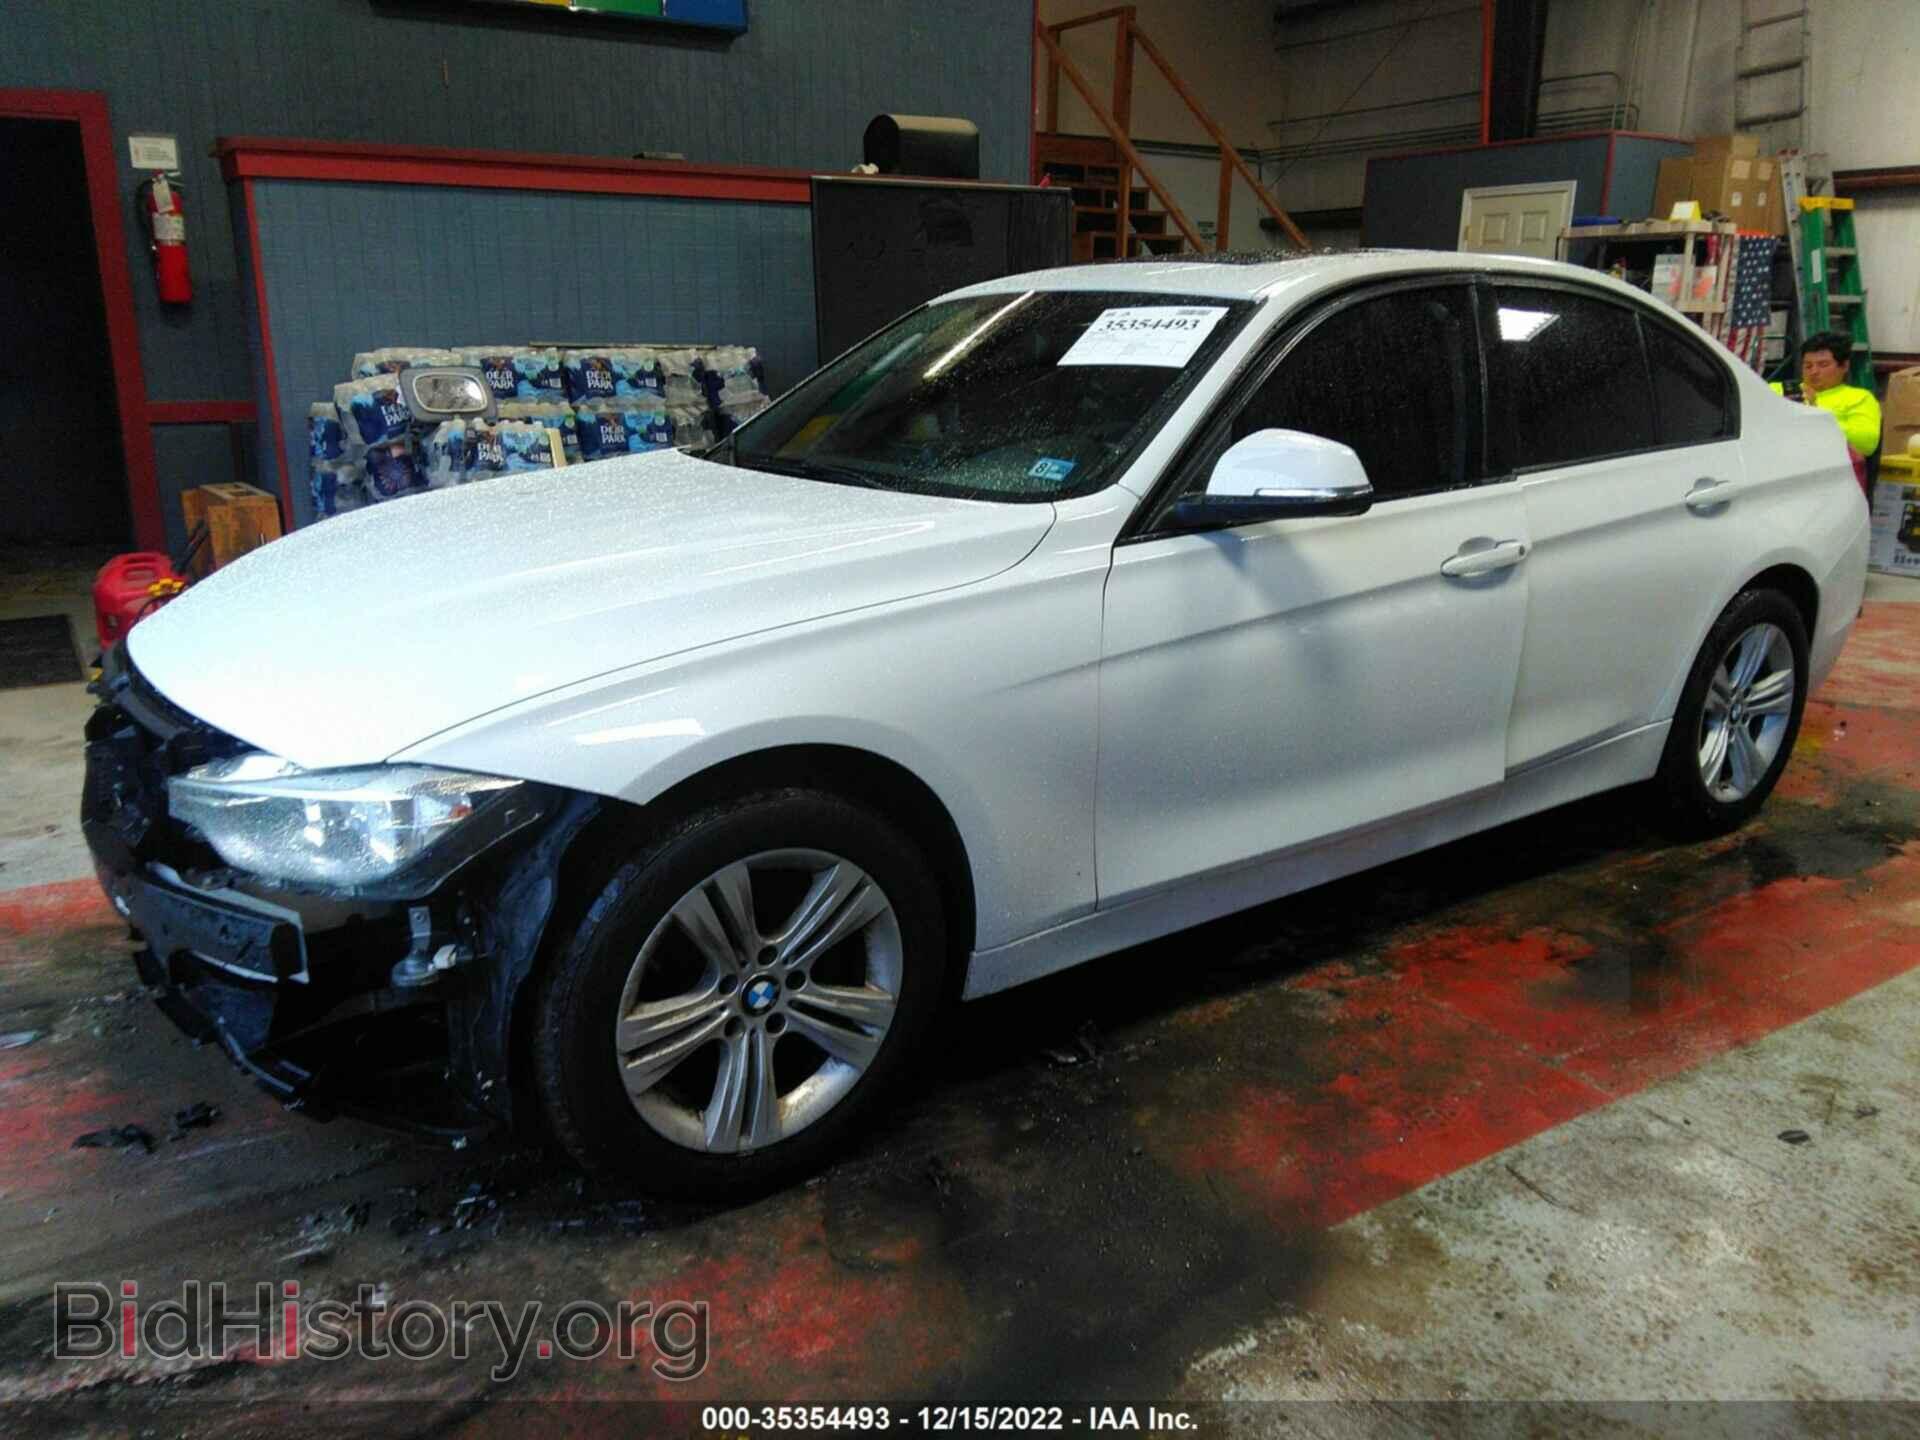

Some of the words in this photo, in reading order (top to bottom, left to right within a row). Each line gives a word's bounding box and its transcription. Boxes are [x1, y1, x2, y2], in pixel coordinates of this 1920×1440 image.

[1098, 319, 1201, 331] 35354493
[587, 379, 614, 390] PARK
[602, 434, 625, 444] PARK
